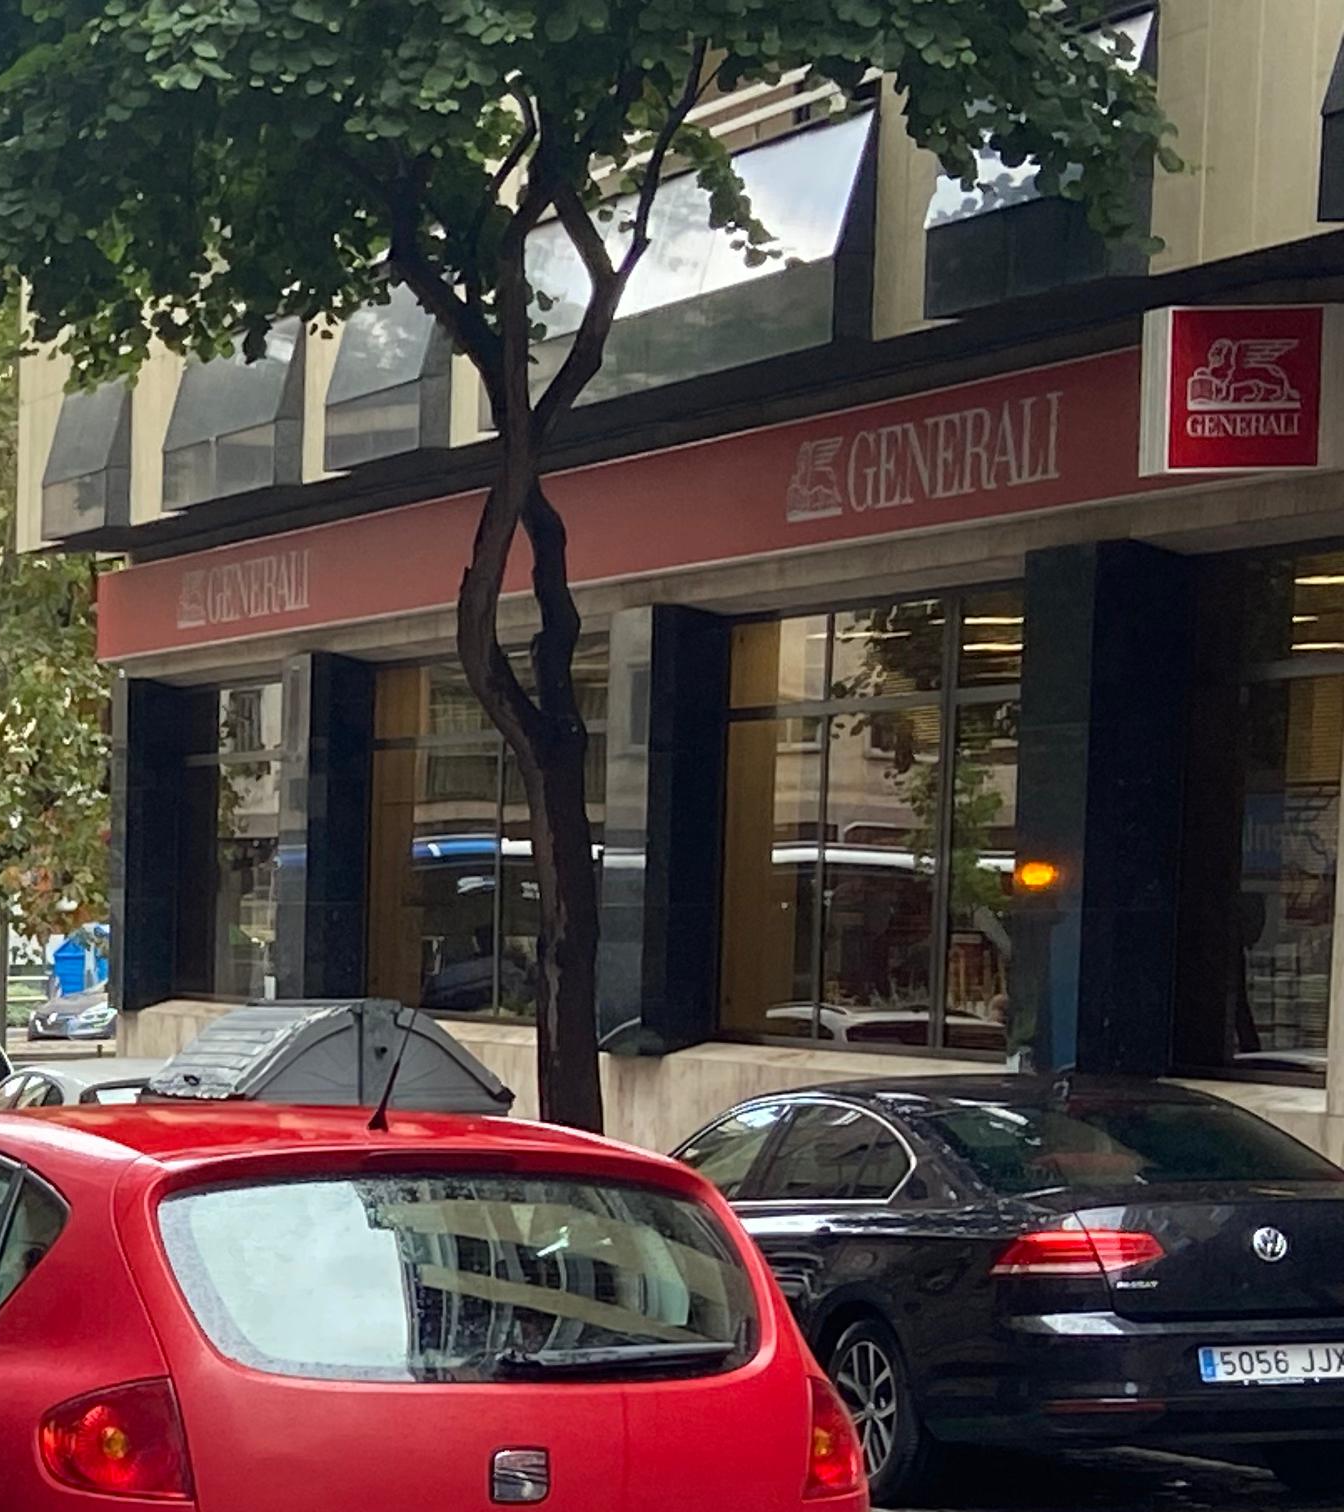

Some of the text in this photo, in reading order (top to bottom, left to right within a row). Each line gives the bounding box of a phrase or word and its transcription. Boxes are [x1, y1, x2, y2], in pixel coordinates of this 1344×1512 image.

[1185, 412, 1301, 438] GENERALI
[847, 392, 1064, 513] GENERALI
[206, 549, 311, 625] GENERALI
[1220, 1350, 1290, 1376] 5056
